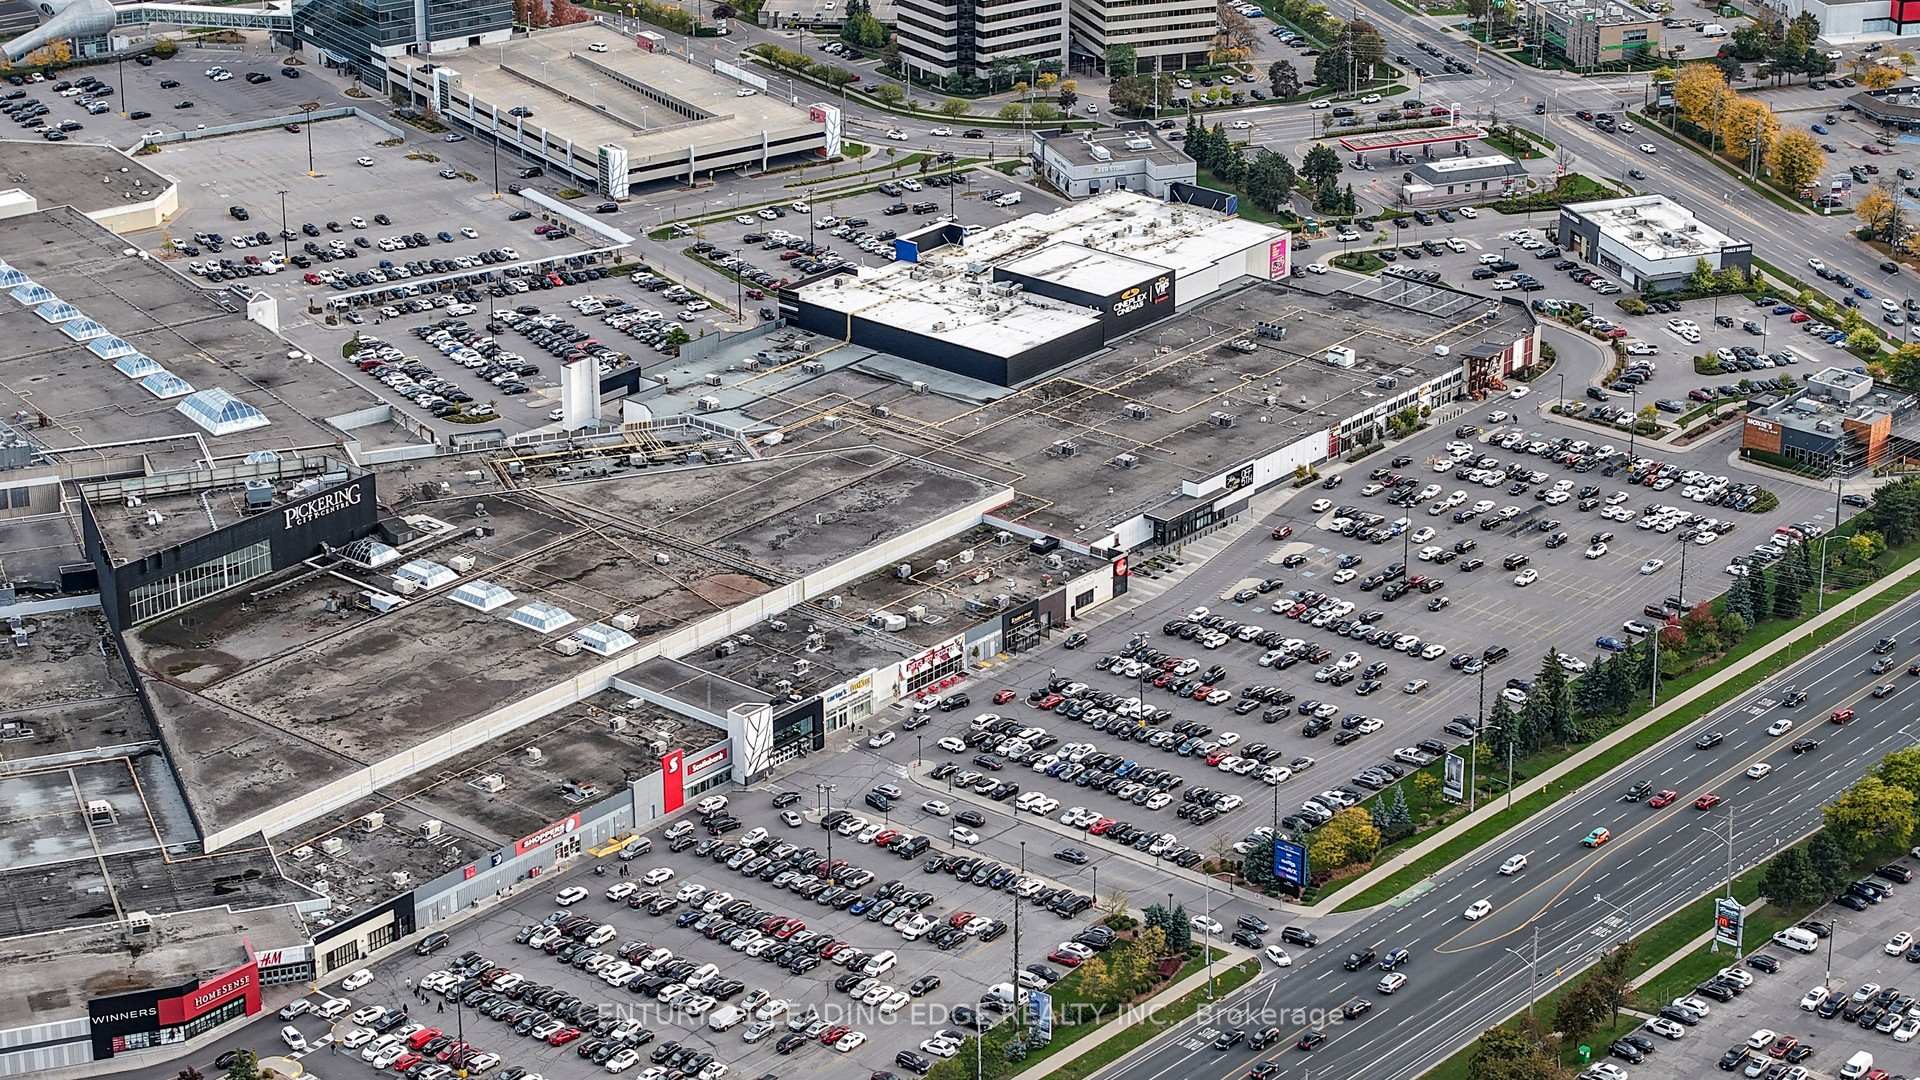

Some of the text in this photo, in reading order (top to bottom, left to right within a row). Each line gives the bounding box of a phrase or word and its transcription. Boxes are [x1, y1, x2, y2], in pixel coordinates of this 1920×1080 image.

[1113, 291, 1147, 311] CINEPLEX
[1116, 302, 1144, 316] CINEMAS
[283, 483, 361, 530] PICKERING
[296, 502, 349, 526] CITY CENTRE
[692, 752, 724, 772] Scotiabank
[523, 824, 565, 848] SHOPPERS
[91, 1007, 157, 1025] WINNERS
